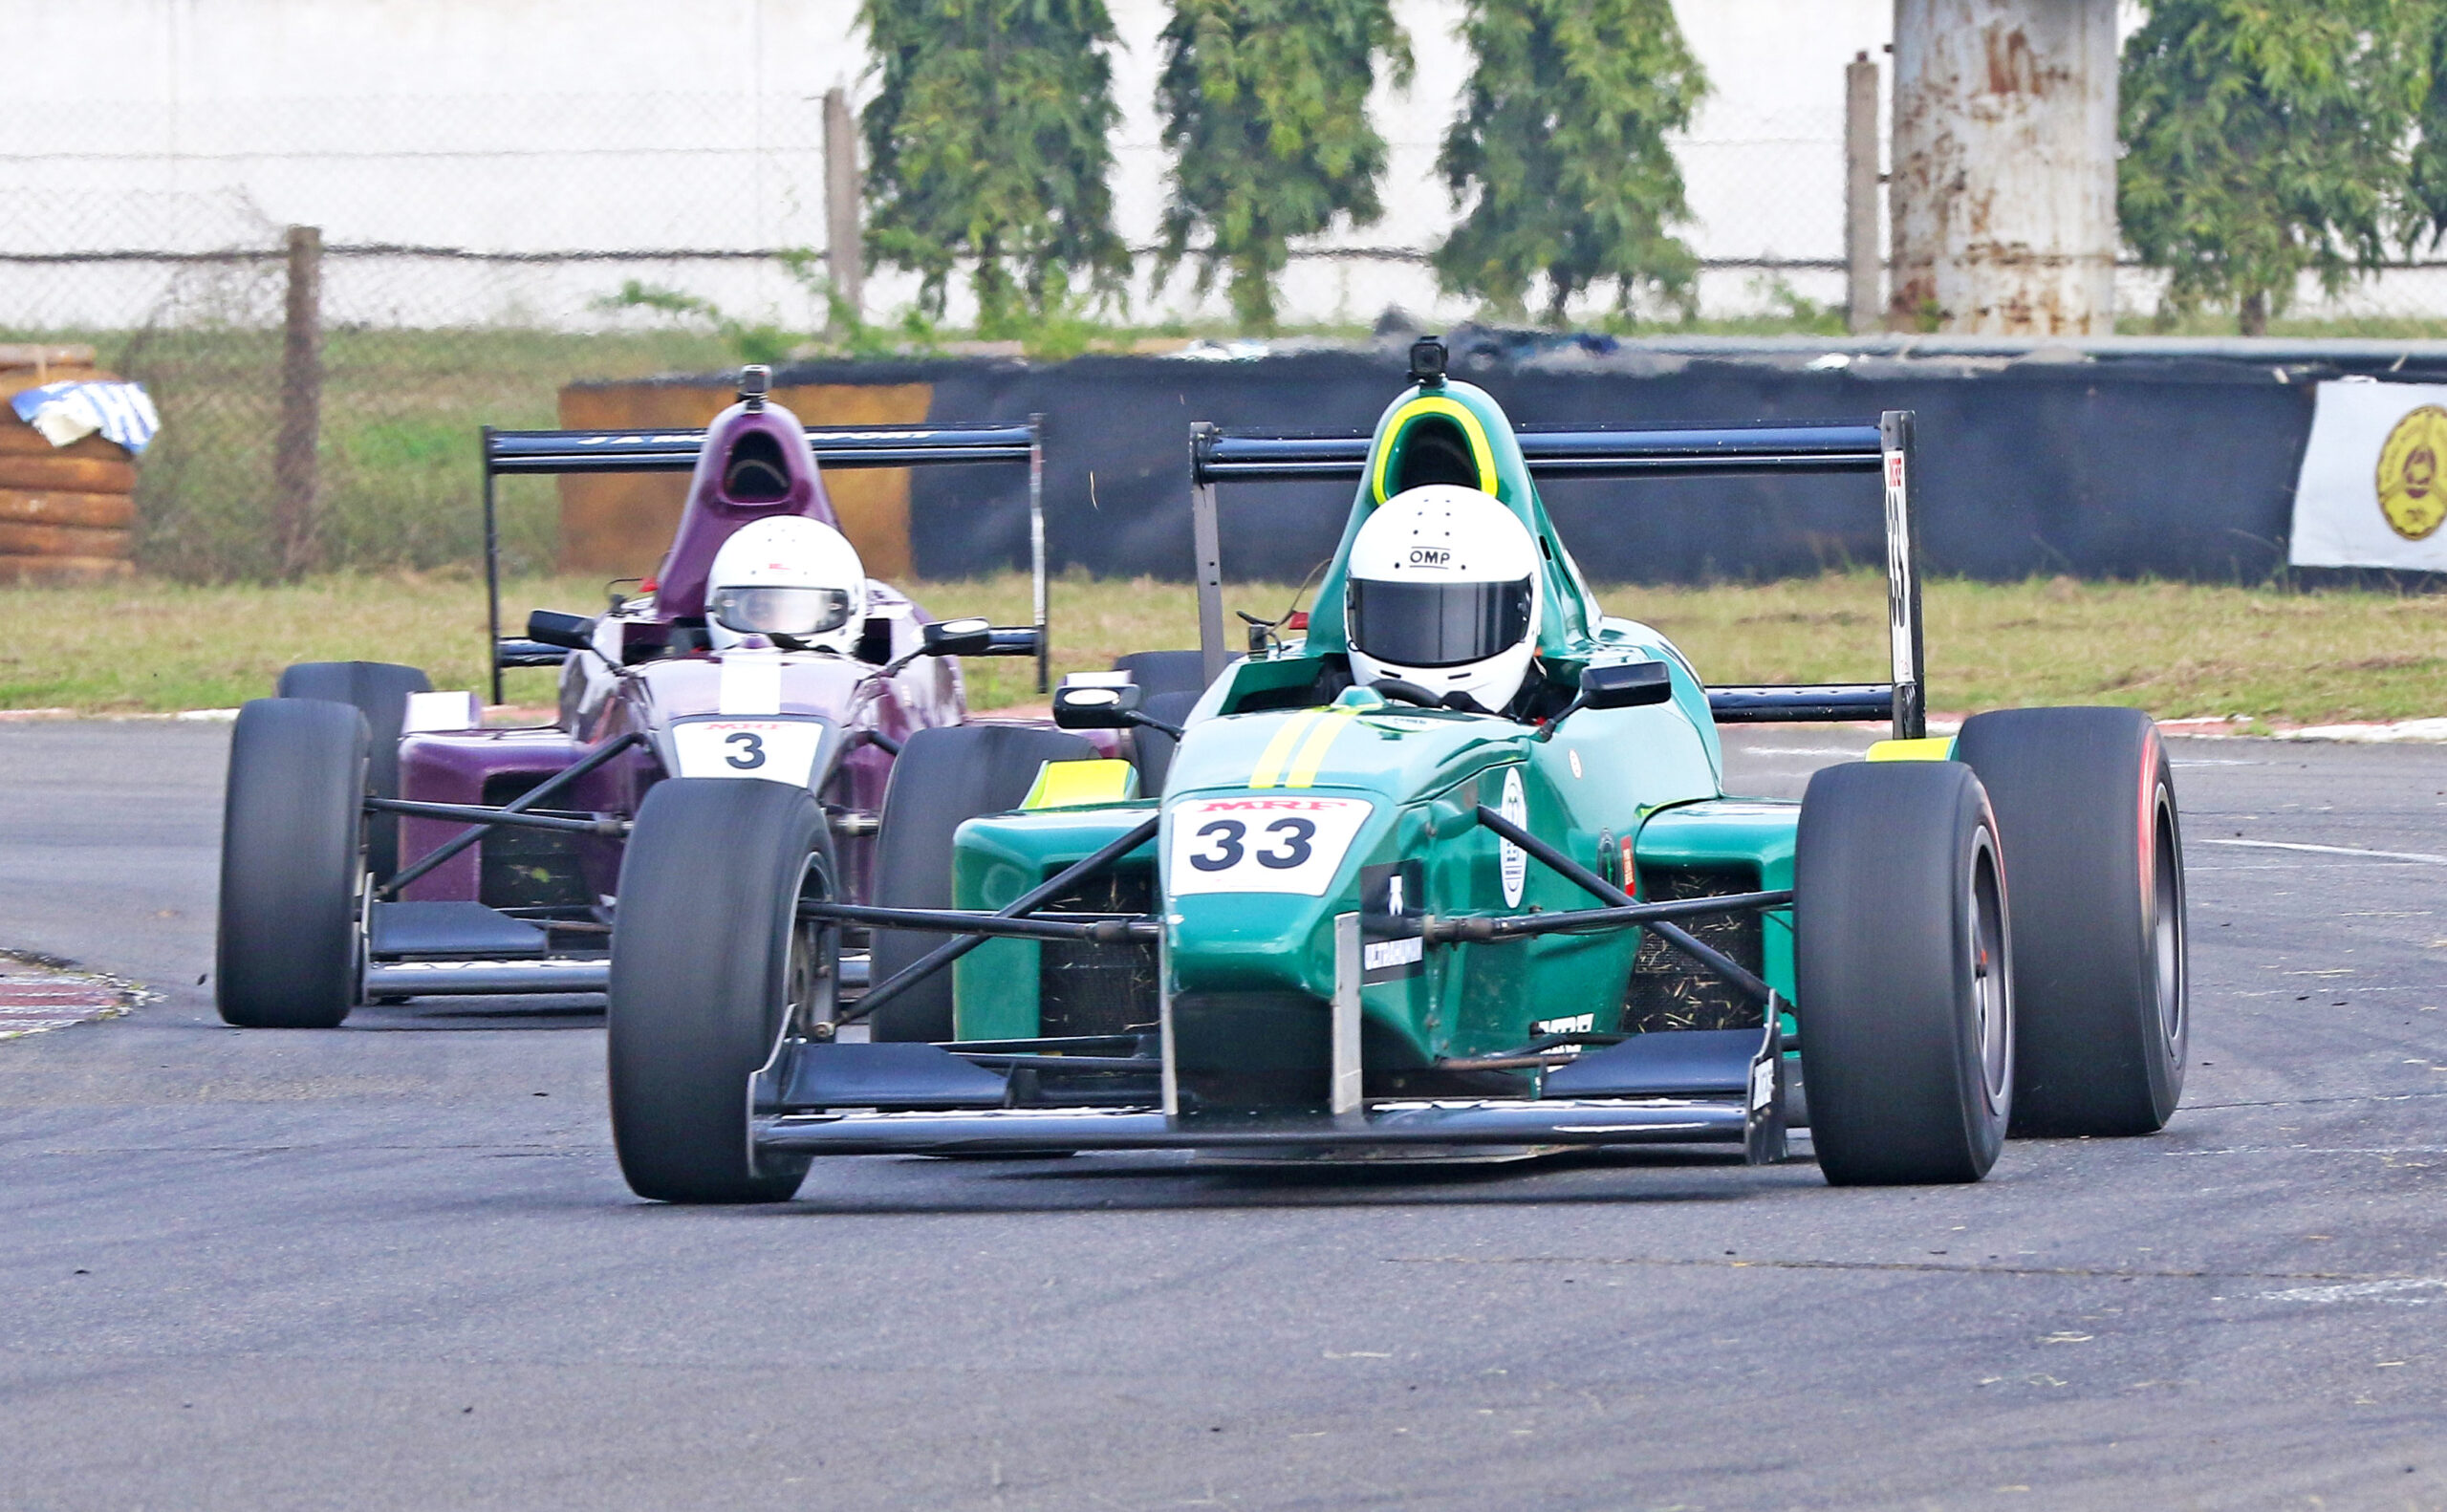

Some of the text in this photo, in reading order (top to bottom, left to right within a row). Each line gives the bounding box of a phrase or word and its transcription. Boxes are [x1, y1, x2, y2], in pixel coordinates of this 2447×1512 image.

[1410, 551, 1450, 564] OMP
[725, 732, 766, 769] 3
[1198, 801, 1347, 811] MRF
[1190, 817, 1316, 872] 33
